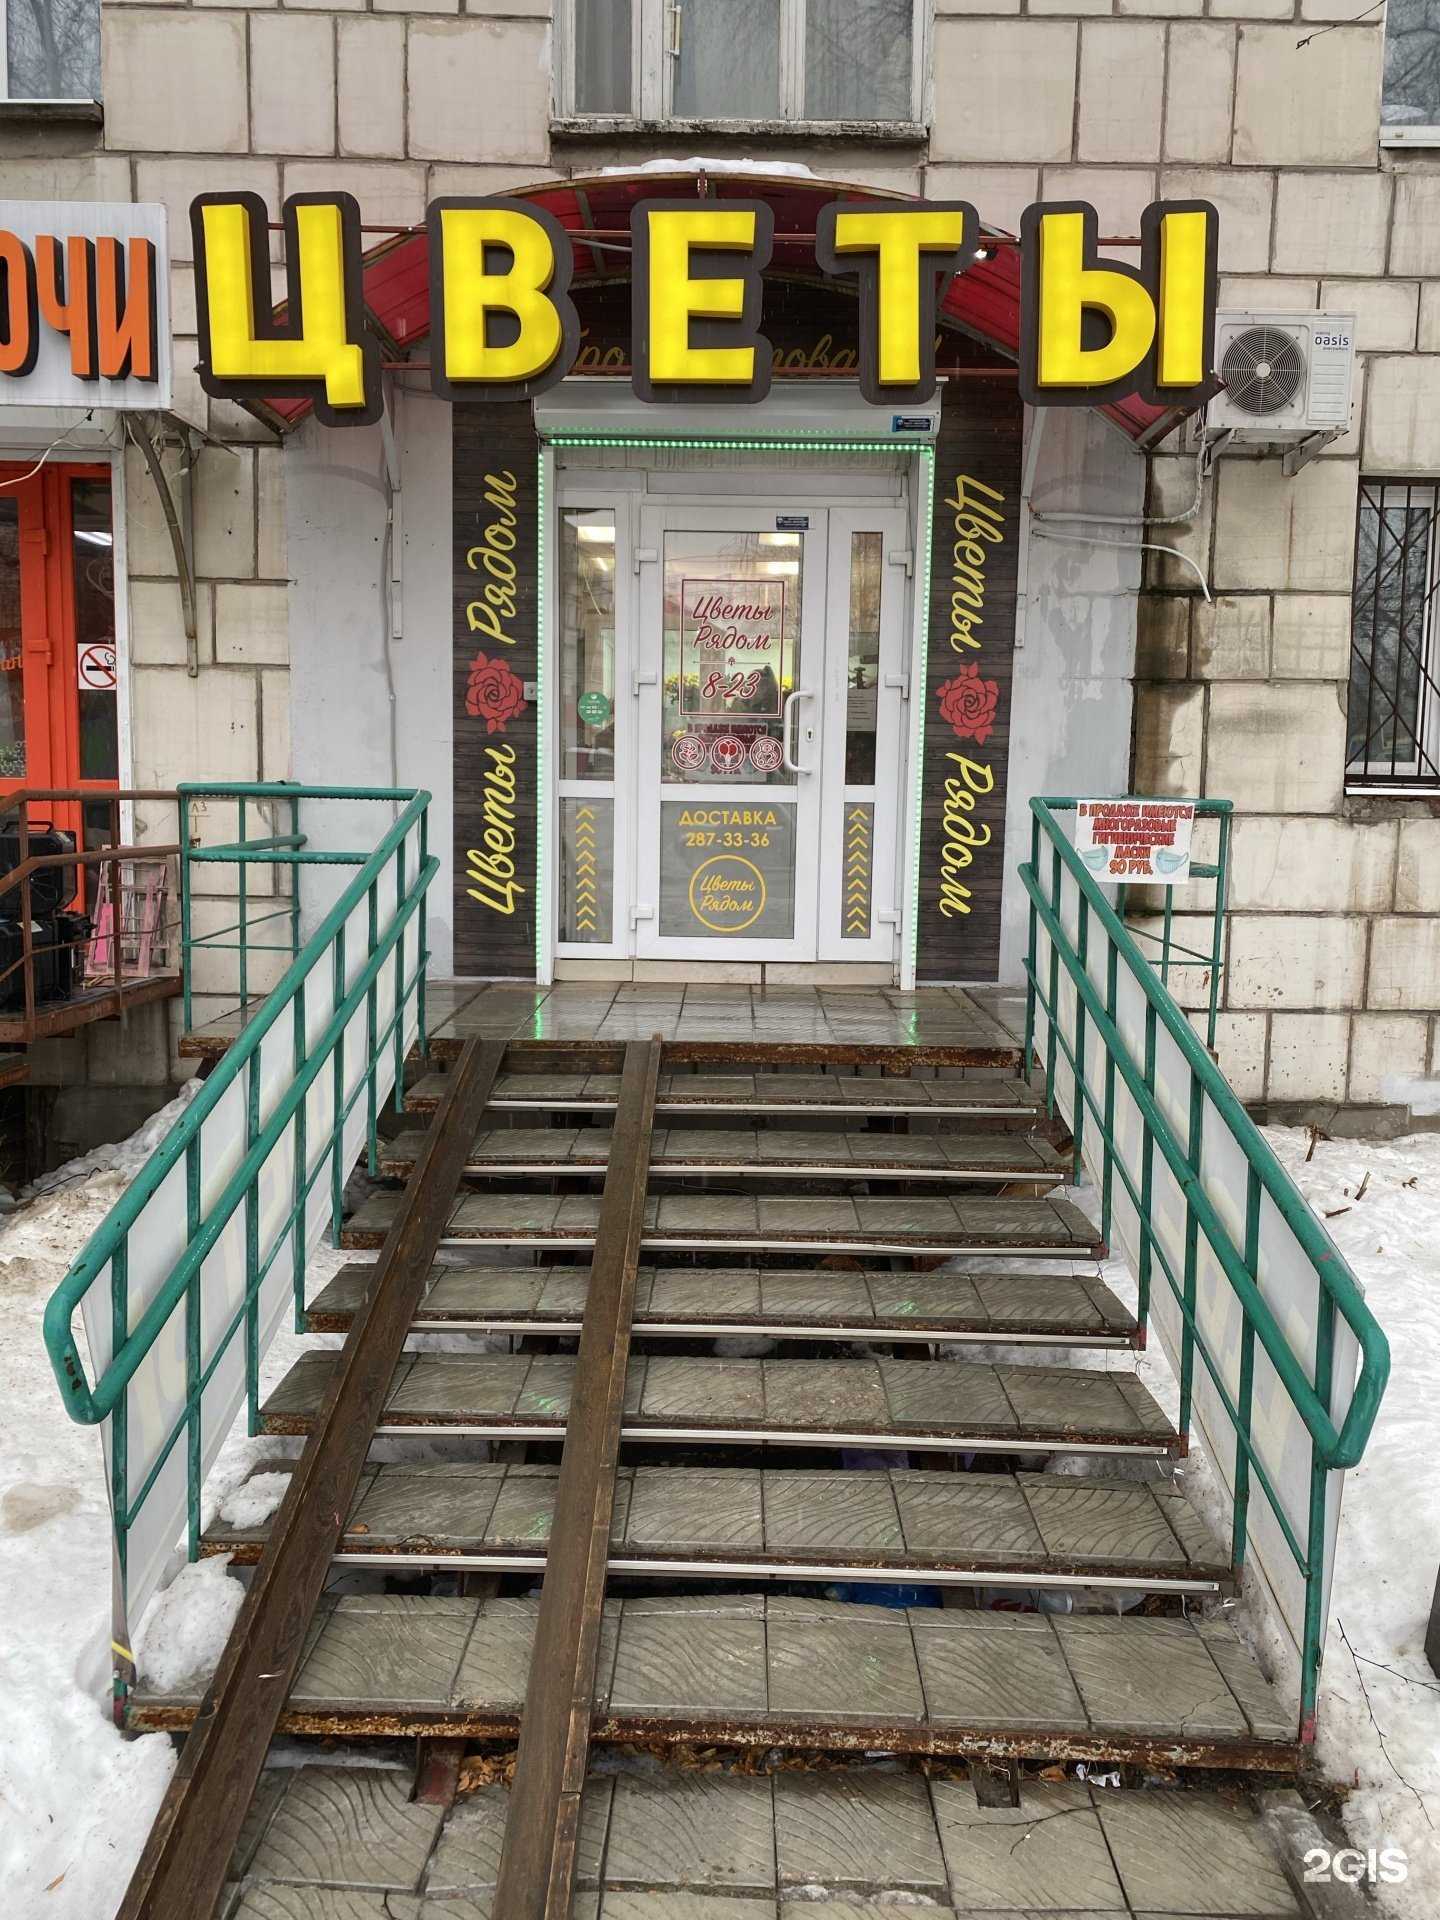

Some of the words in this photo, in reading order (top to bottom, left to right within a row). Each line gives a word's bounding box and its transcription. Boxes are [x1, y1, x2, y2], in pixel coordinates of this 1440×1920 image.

[199, 203, 1208, 410] ЦВЕТЫ
[1314, 334, 1350, 347] oasis
[466, 470, 518, 645] Рядом
[943, 473, 1006, 654] Цветы
[692, 595, 774, 624] Цветы
[693, 625, 772, 650] Рядом
[702, 671, 762, 698] 8-23
[679, 810, 776, 825] ДОСТАВКА
[1089, 803, 1140, 818] ПРОДАЖЕ
[1142, 804, 1194, 819] ИМЕЮТСЯ
[465, 743, 526, 915] Цветы
[686, 831, 770, 847] 287-33-36
[938, 751, 995, 918] Рядом
[1114, 845, 1152, 859] МАСКИ
[700, 874, 755, 894] Цветы
[700, 895, 755, 912] Рядом
